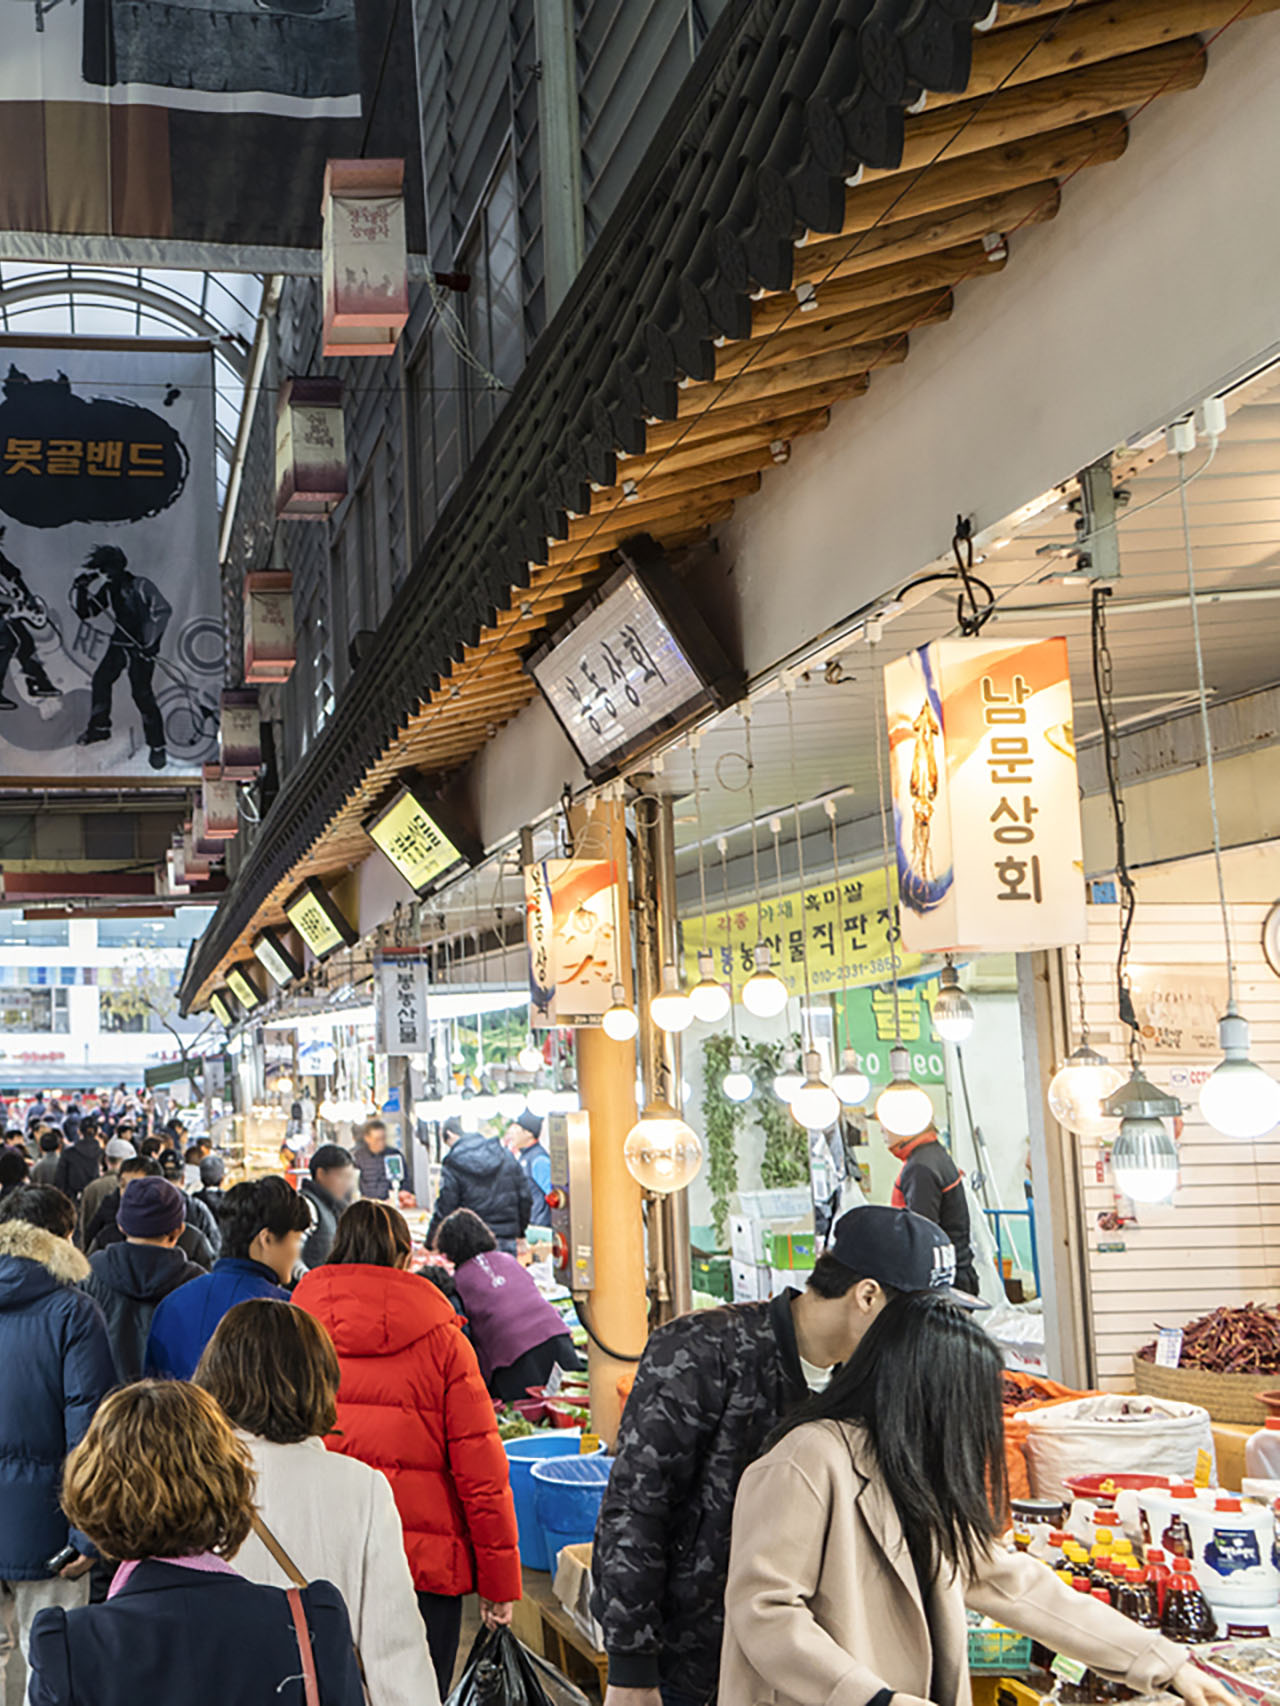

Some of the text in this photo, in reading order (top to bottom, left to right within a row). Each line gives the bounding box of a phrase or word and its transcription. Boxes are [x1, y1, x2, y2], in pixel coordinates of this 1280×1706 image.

[3, 437, 165, 477] 못골밴드
[983, 676, 1042, 904] 남문상회
[1189, 1071, 1212, 1085] CCT
